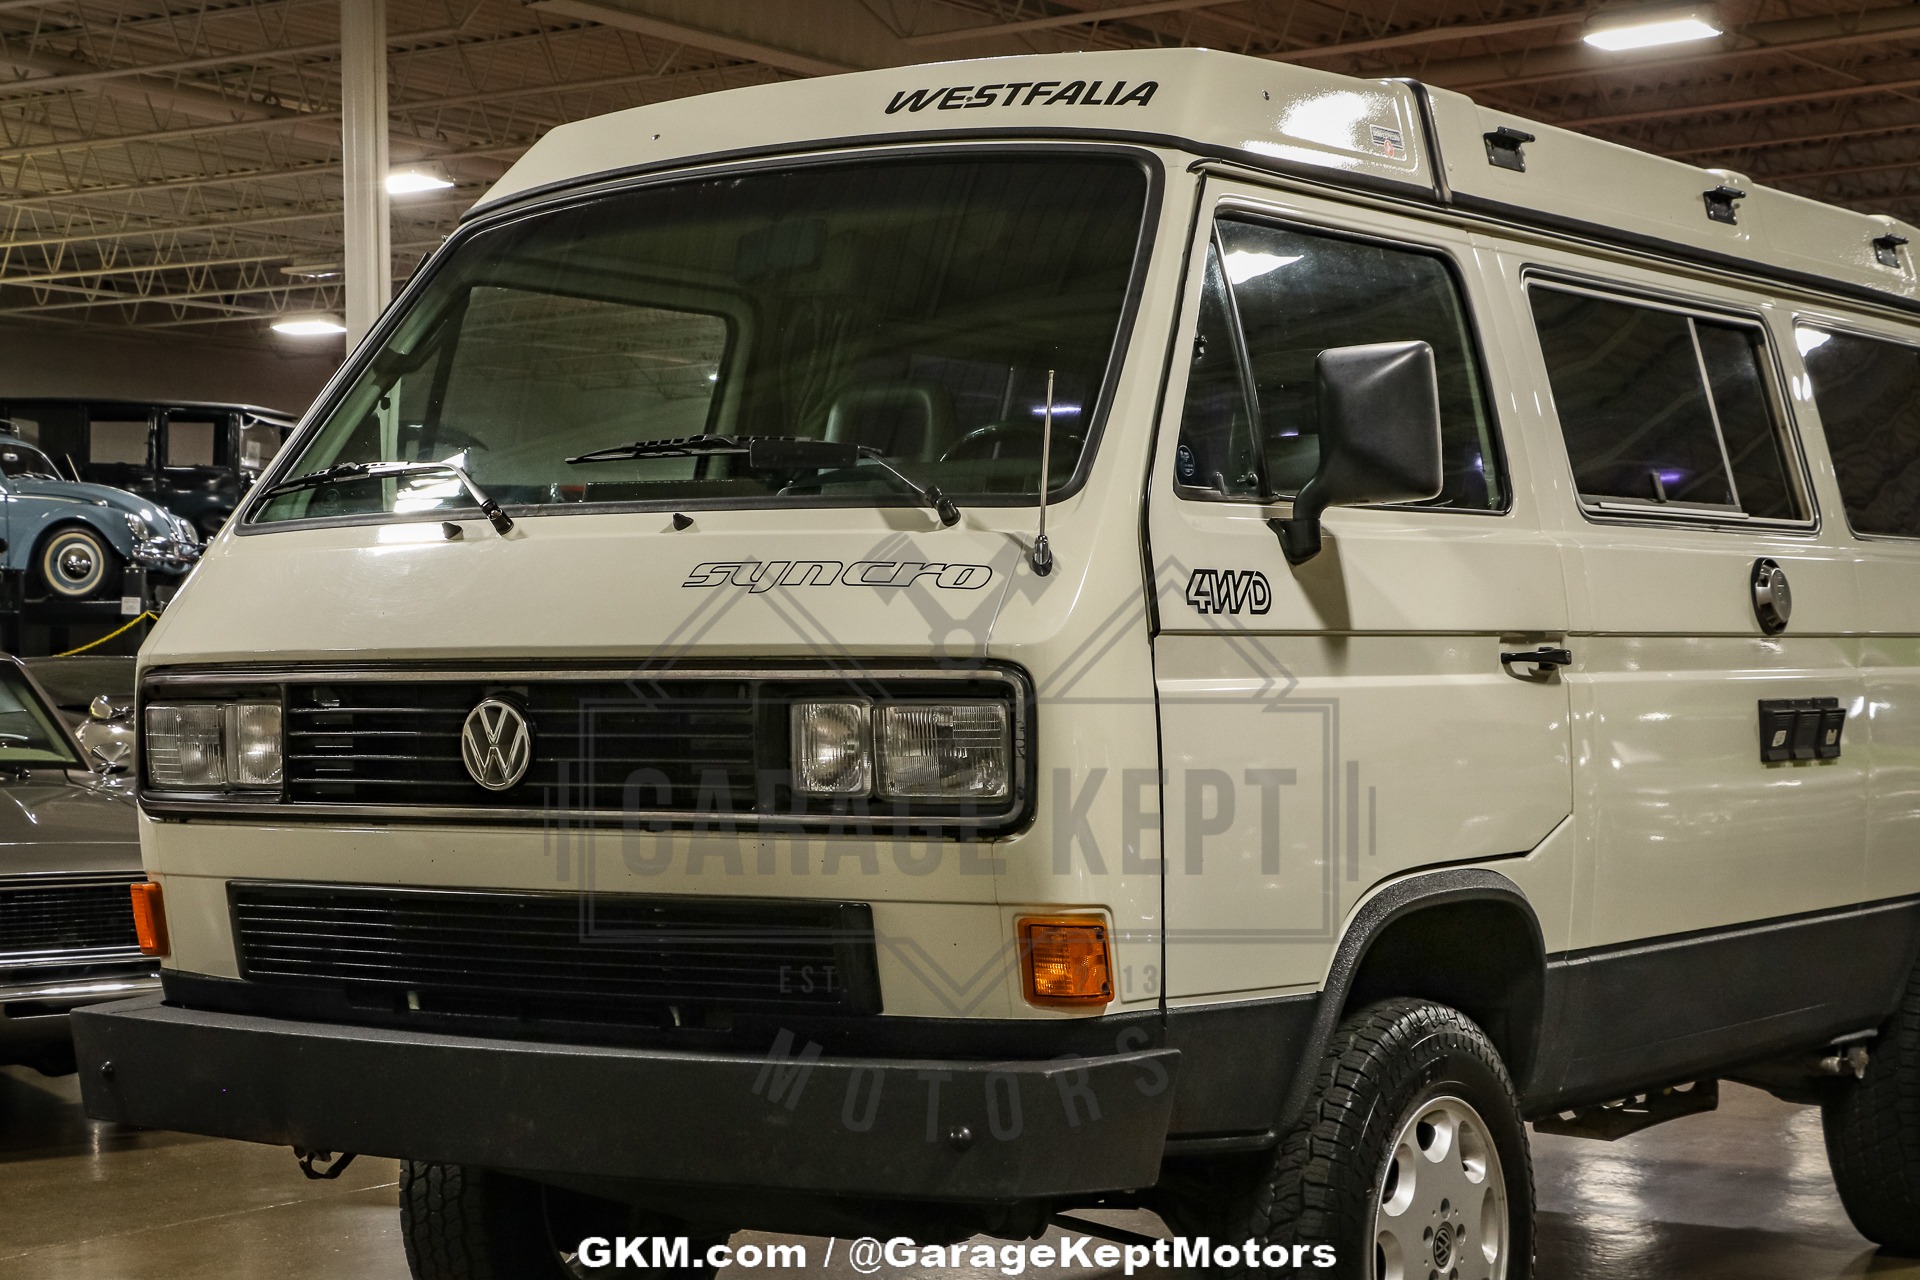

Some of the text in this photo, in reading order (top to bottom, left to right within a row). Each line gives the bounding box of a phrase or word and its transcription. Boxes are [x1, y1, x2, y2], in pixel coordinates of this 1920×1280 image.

[885, 80, 1159, 114] WESTFALIA
[682, 561, 993, 593] syncro
[1186, 569, 1271, 614] 4WD
